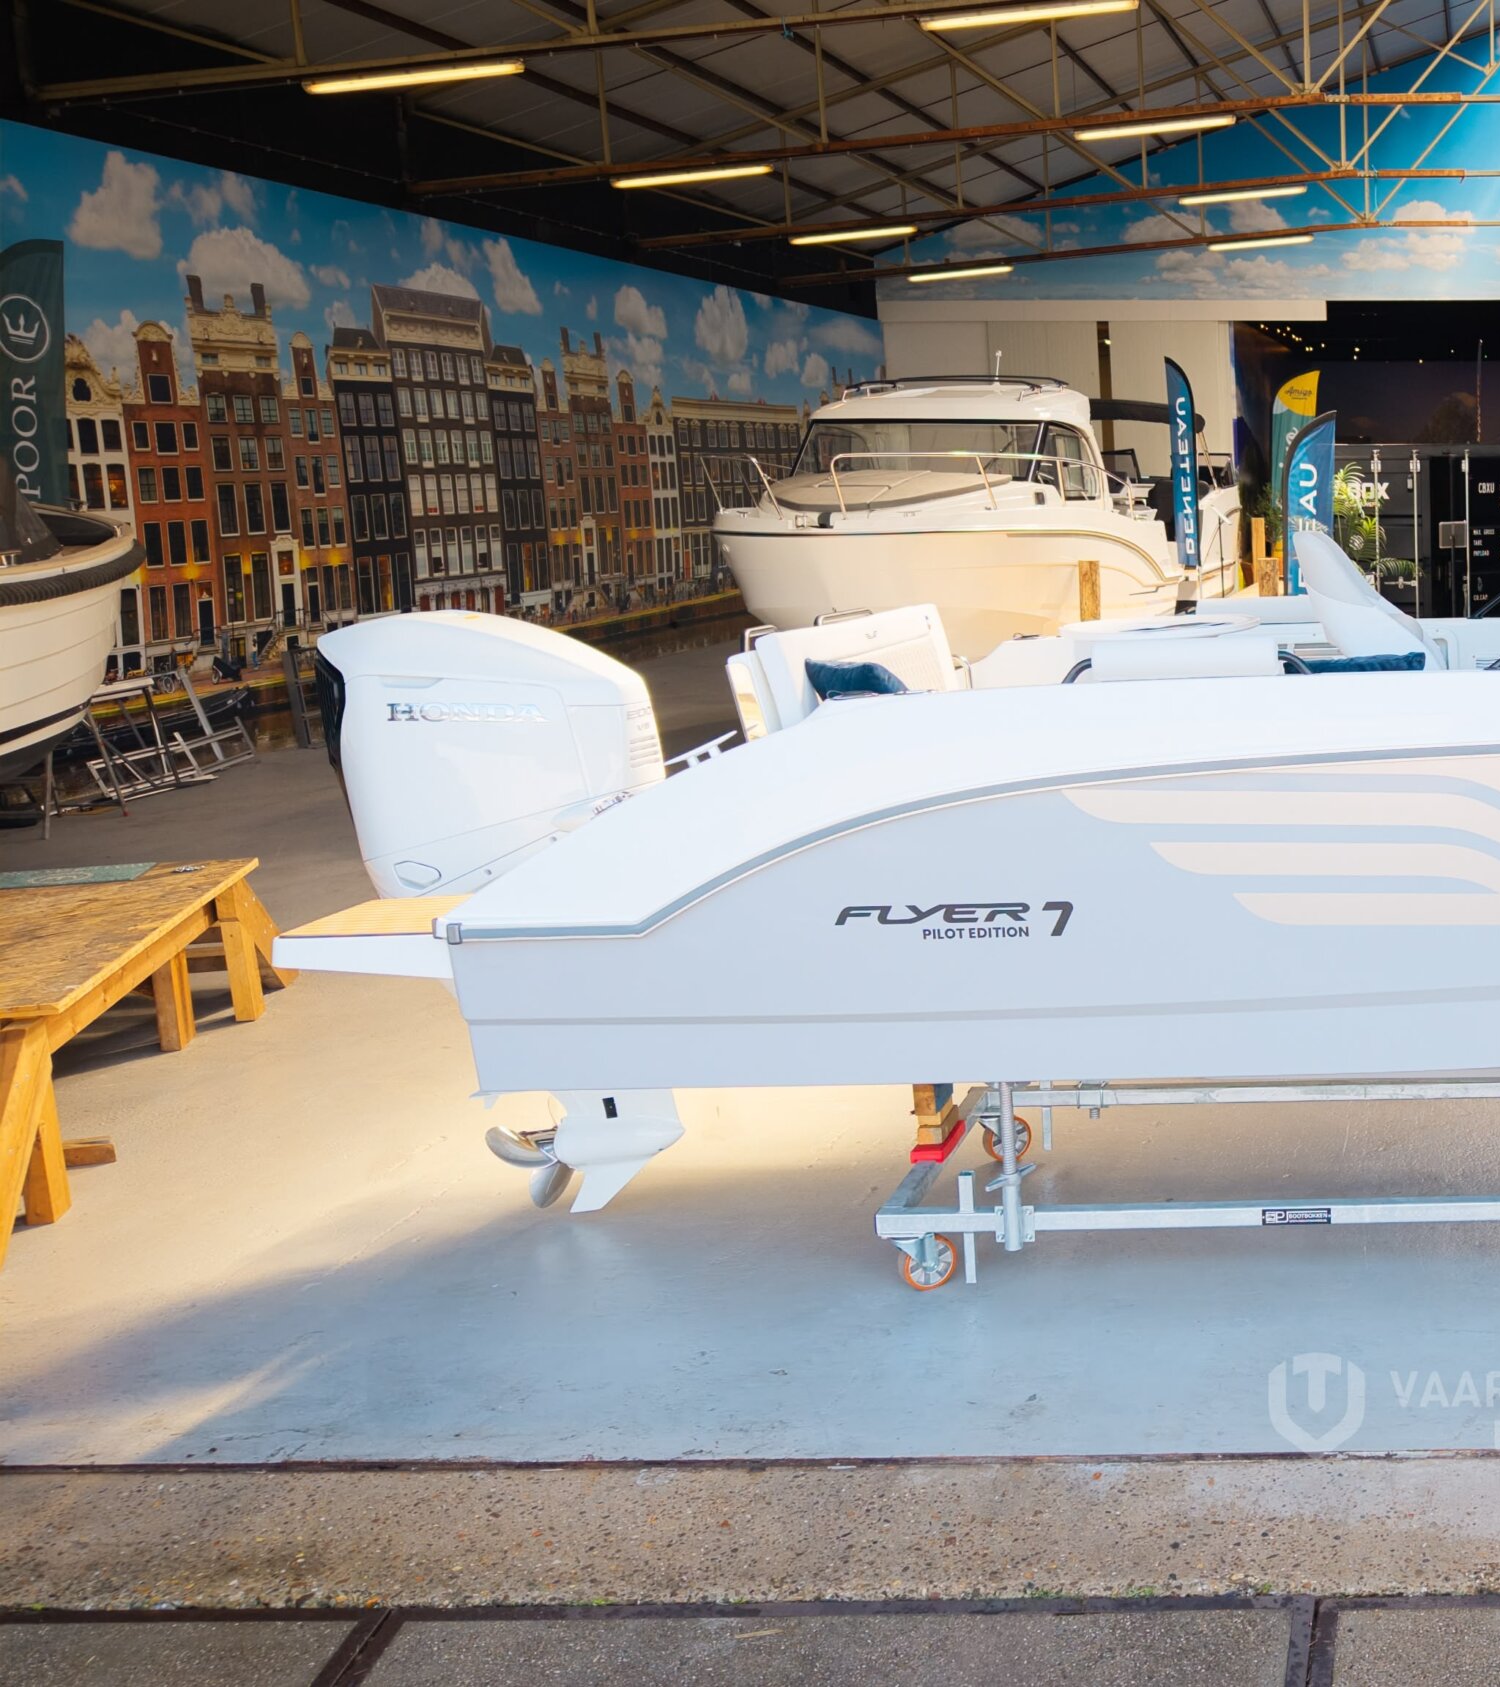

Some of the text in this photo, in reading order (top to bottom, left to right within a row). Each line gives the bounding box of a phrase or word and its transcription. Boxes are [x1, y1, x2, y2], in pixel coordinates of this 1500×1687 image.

[1478, 482, 1495, 493] CBXU
[386, 702, 551, 722] HONDA
[835, 901, 1074, 937] FLYER 7
[923, 926, 1030, 940] PILOT EDITION
